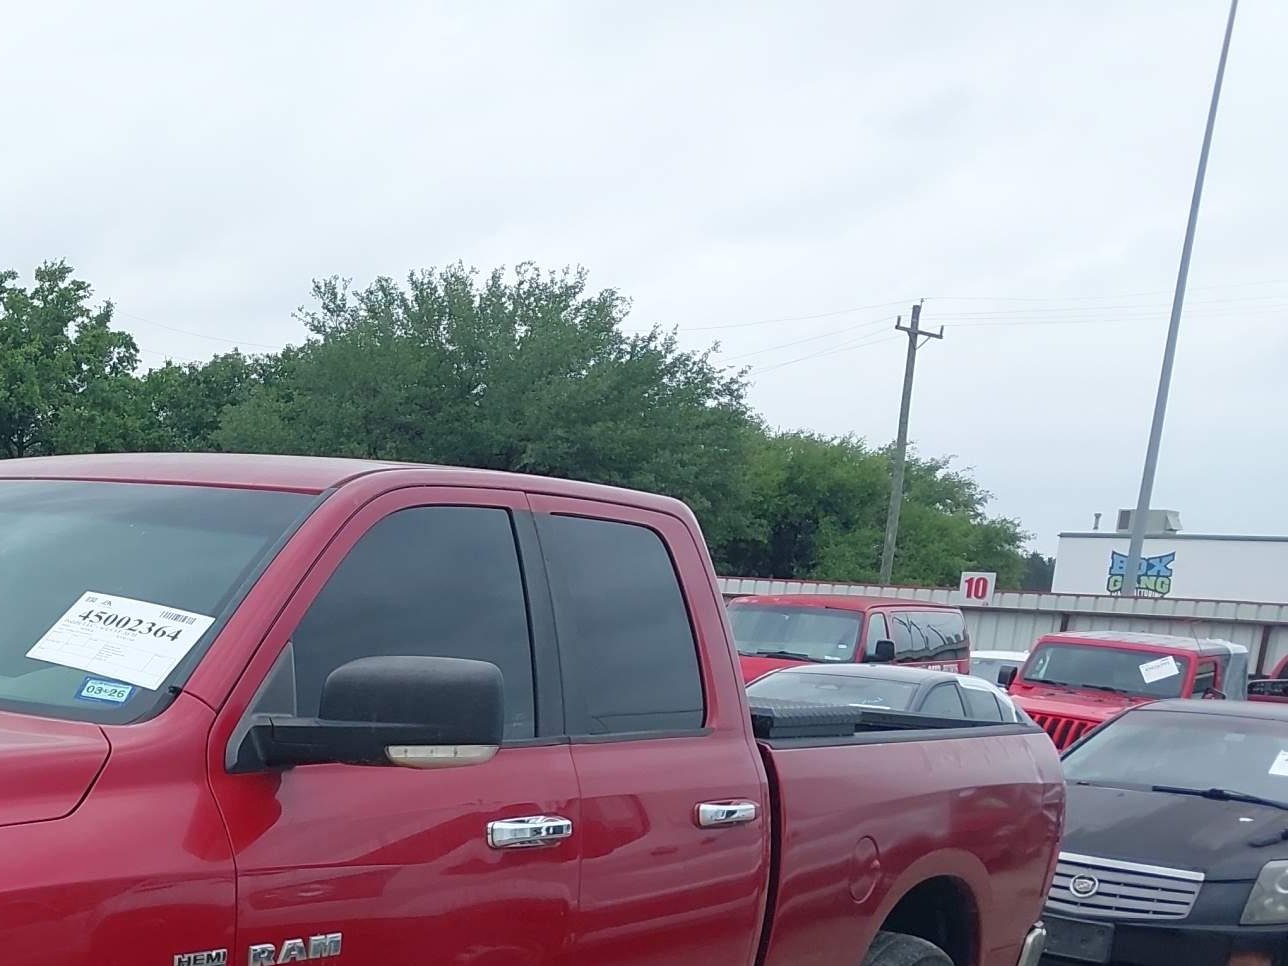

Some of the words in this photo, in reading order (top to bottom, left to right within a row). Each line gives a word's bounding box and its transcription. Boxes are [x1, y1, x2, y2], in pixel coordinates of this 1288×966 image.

[965, 576, 988, 599] 10
[1107, 575, 1171, 594] GNG
[78, 608, 183, 642] 45002364
[85, 684, 103, 696] 03
[108, 688, 127, 699] 26
